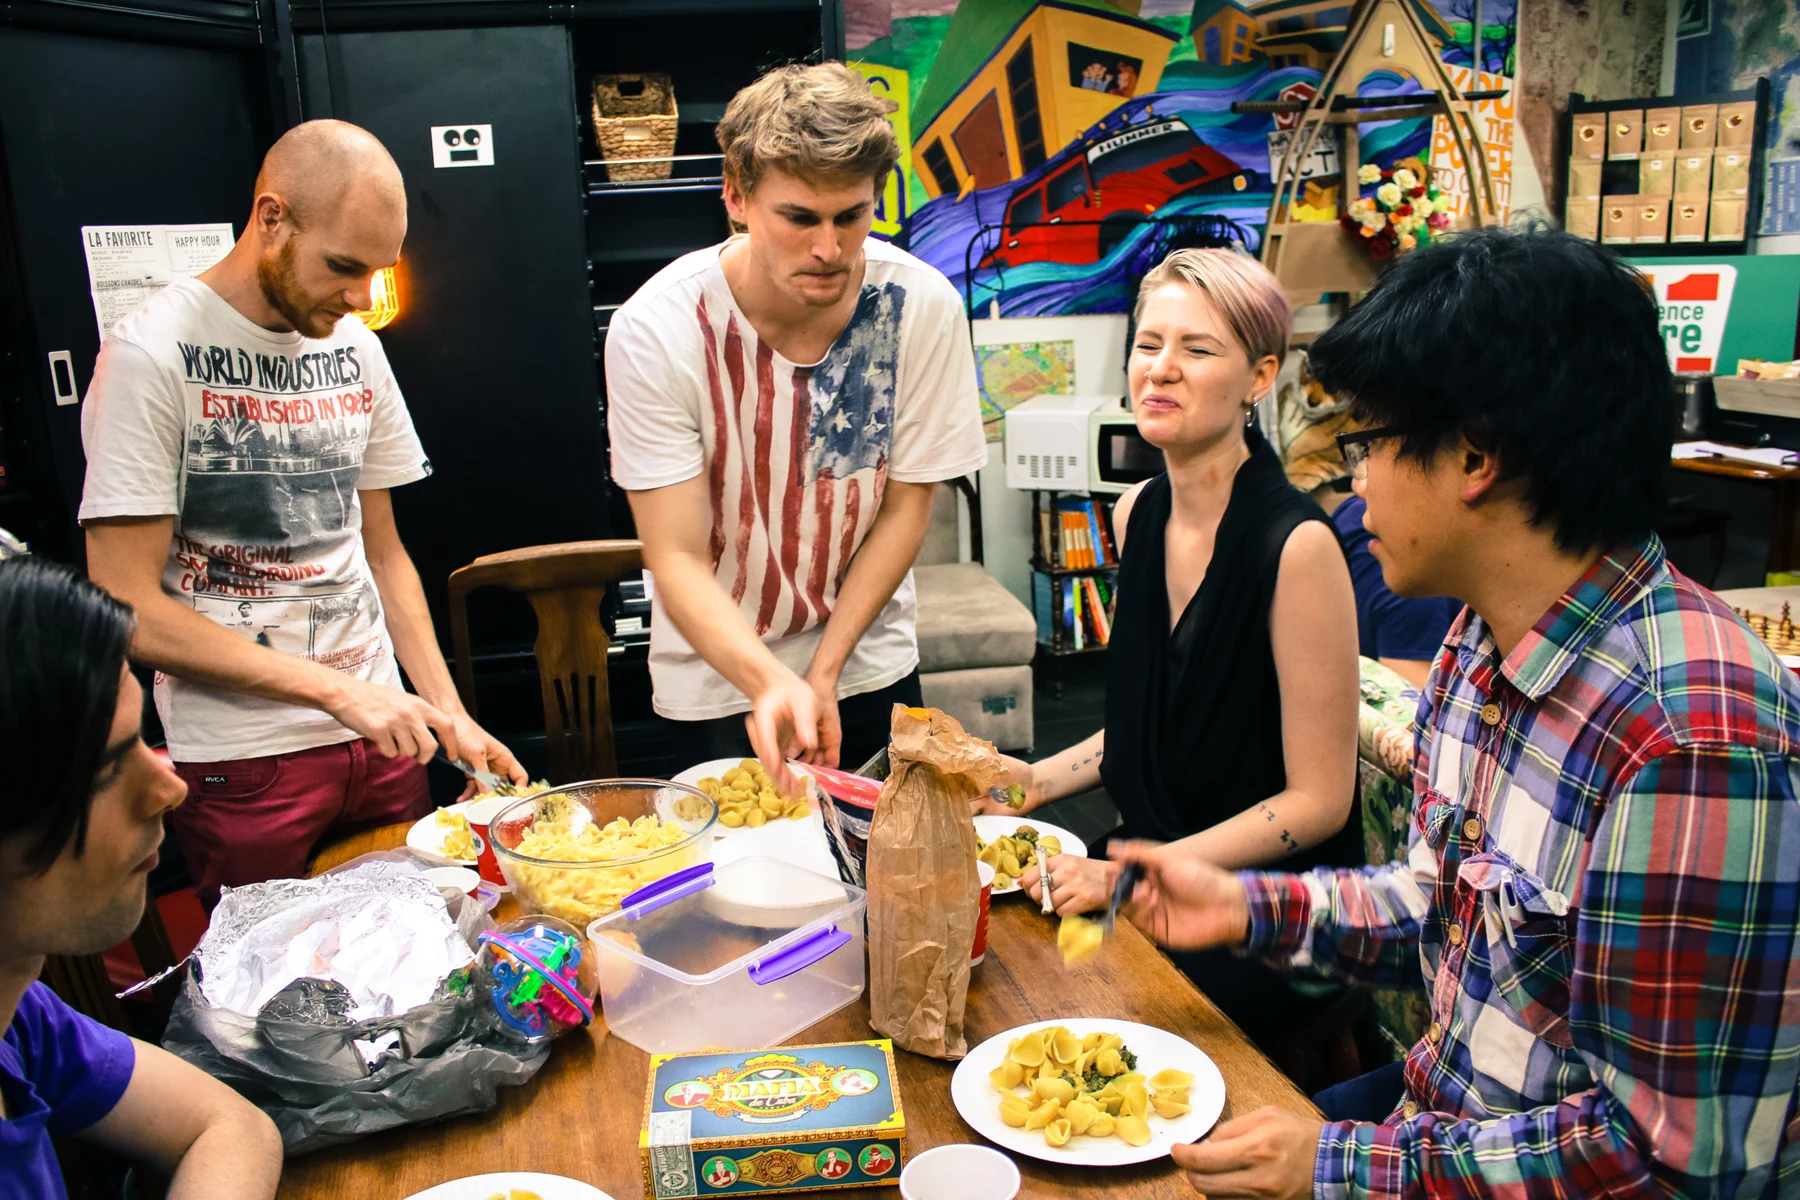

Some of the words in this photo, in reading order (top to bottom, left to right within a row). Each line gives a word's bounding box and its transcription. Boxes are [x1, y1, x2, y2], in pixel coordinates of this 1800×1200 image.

[1099, 123, 1172, 152] HUMMER
[1432, 133, 1512, 178] POER
[88, 232, 102, 247] LA
[105, 231, 153, 247] FAVORITE
[175, 236, 199, 247] HAPPY
[201, 235, 220, 246] HOUR
[96, 280, 120, 288] BOISSONS
[177, 341, 252, 386] WORLD
[256, 346, 361, 392] INDUSTRIES
[203, 389, 315, 424] ESTABLISHED
[318, 397, 336, 420] IN
[177, 537, 208, 557] THE
[210, 545, 294, 566] ORIGINAL
[727, 1079, 818, 1099] MAFIA
[748, 1098, 764, 1107] de
[765, 1094, 798, 1107] Cuba
